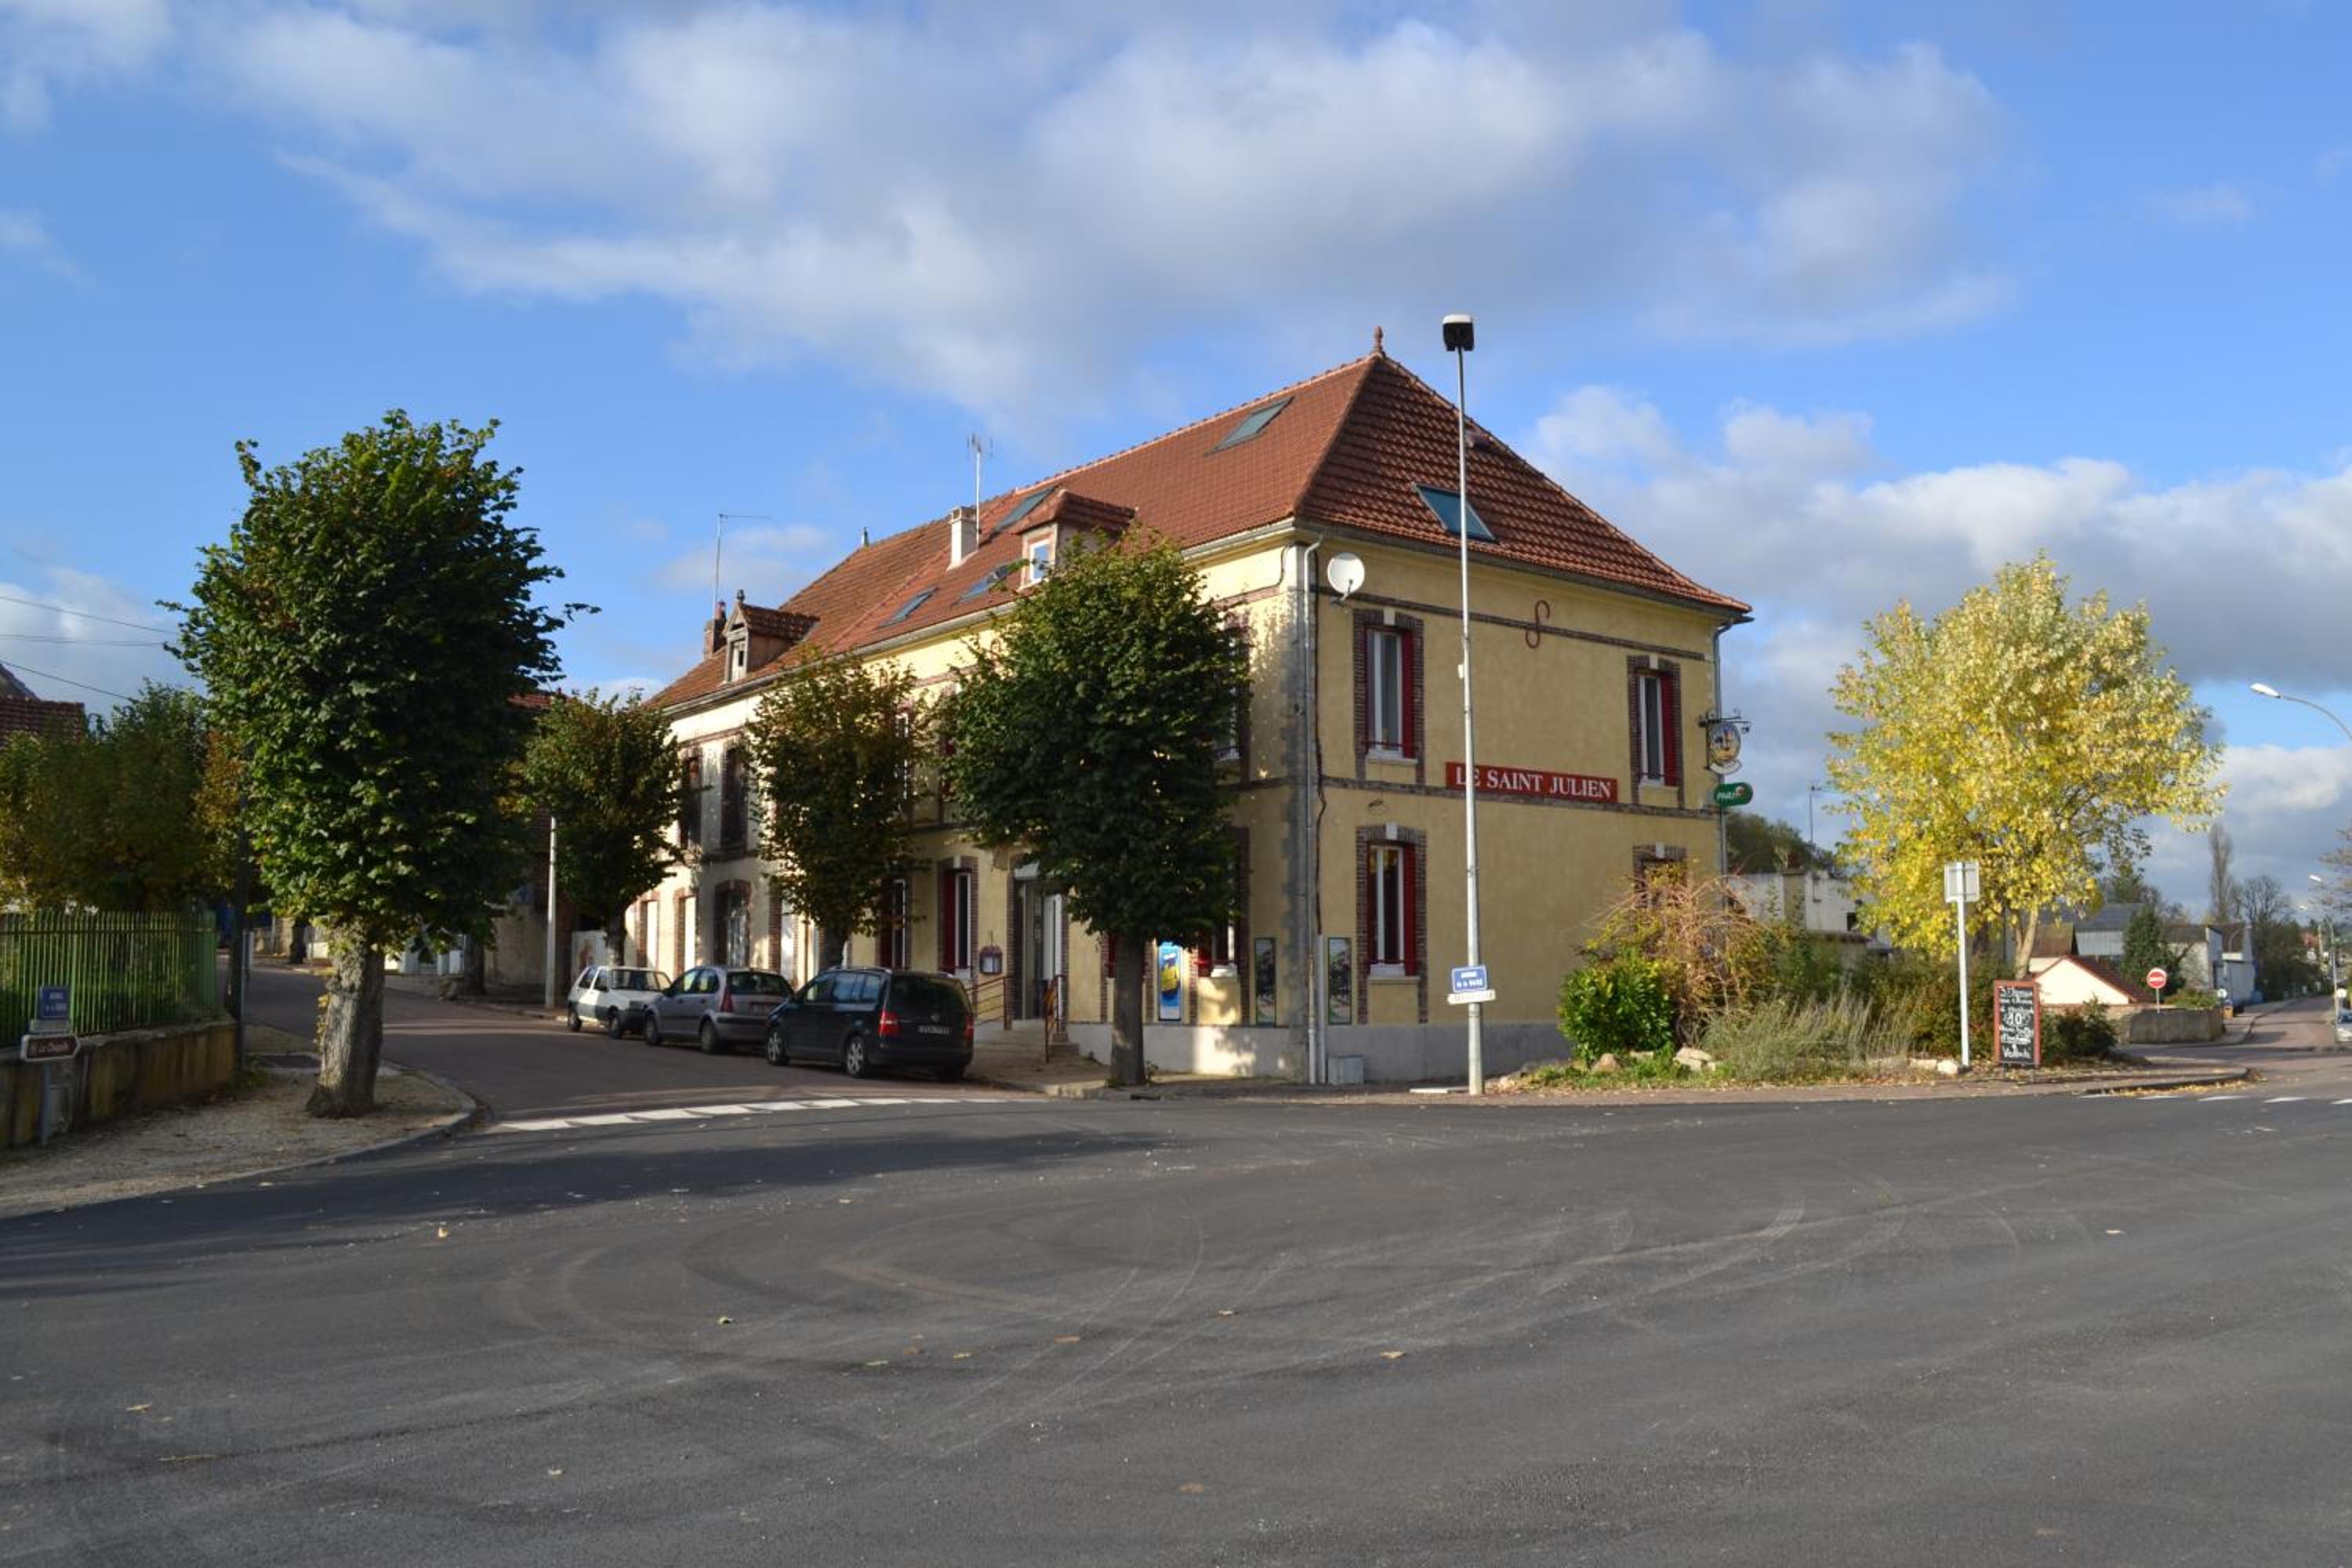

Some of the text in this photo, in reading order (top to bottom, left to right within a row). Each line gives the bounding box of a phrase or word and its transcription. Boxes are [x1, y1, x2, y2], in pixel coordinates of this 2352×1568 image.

[1456, 767, 1610, 797] LE SAINT JULIEN
